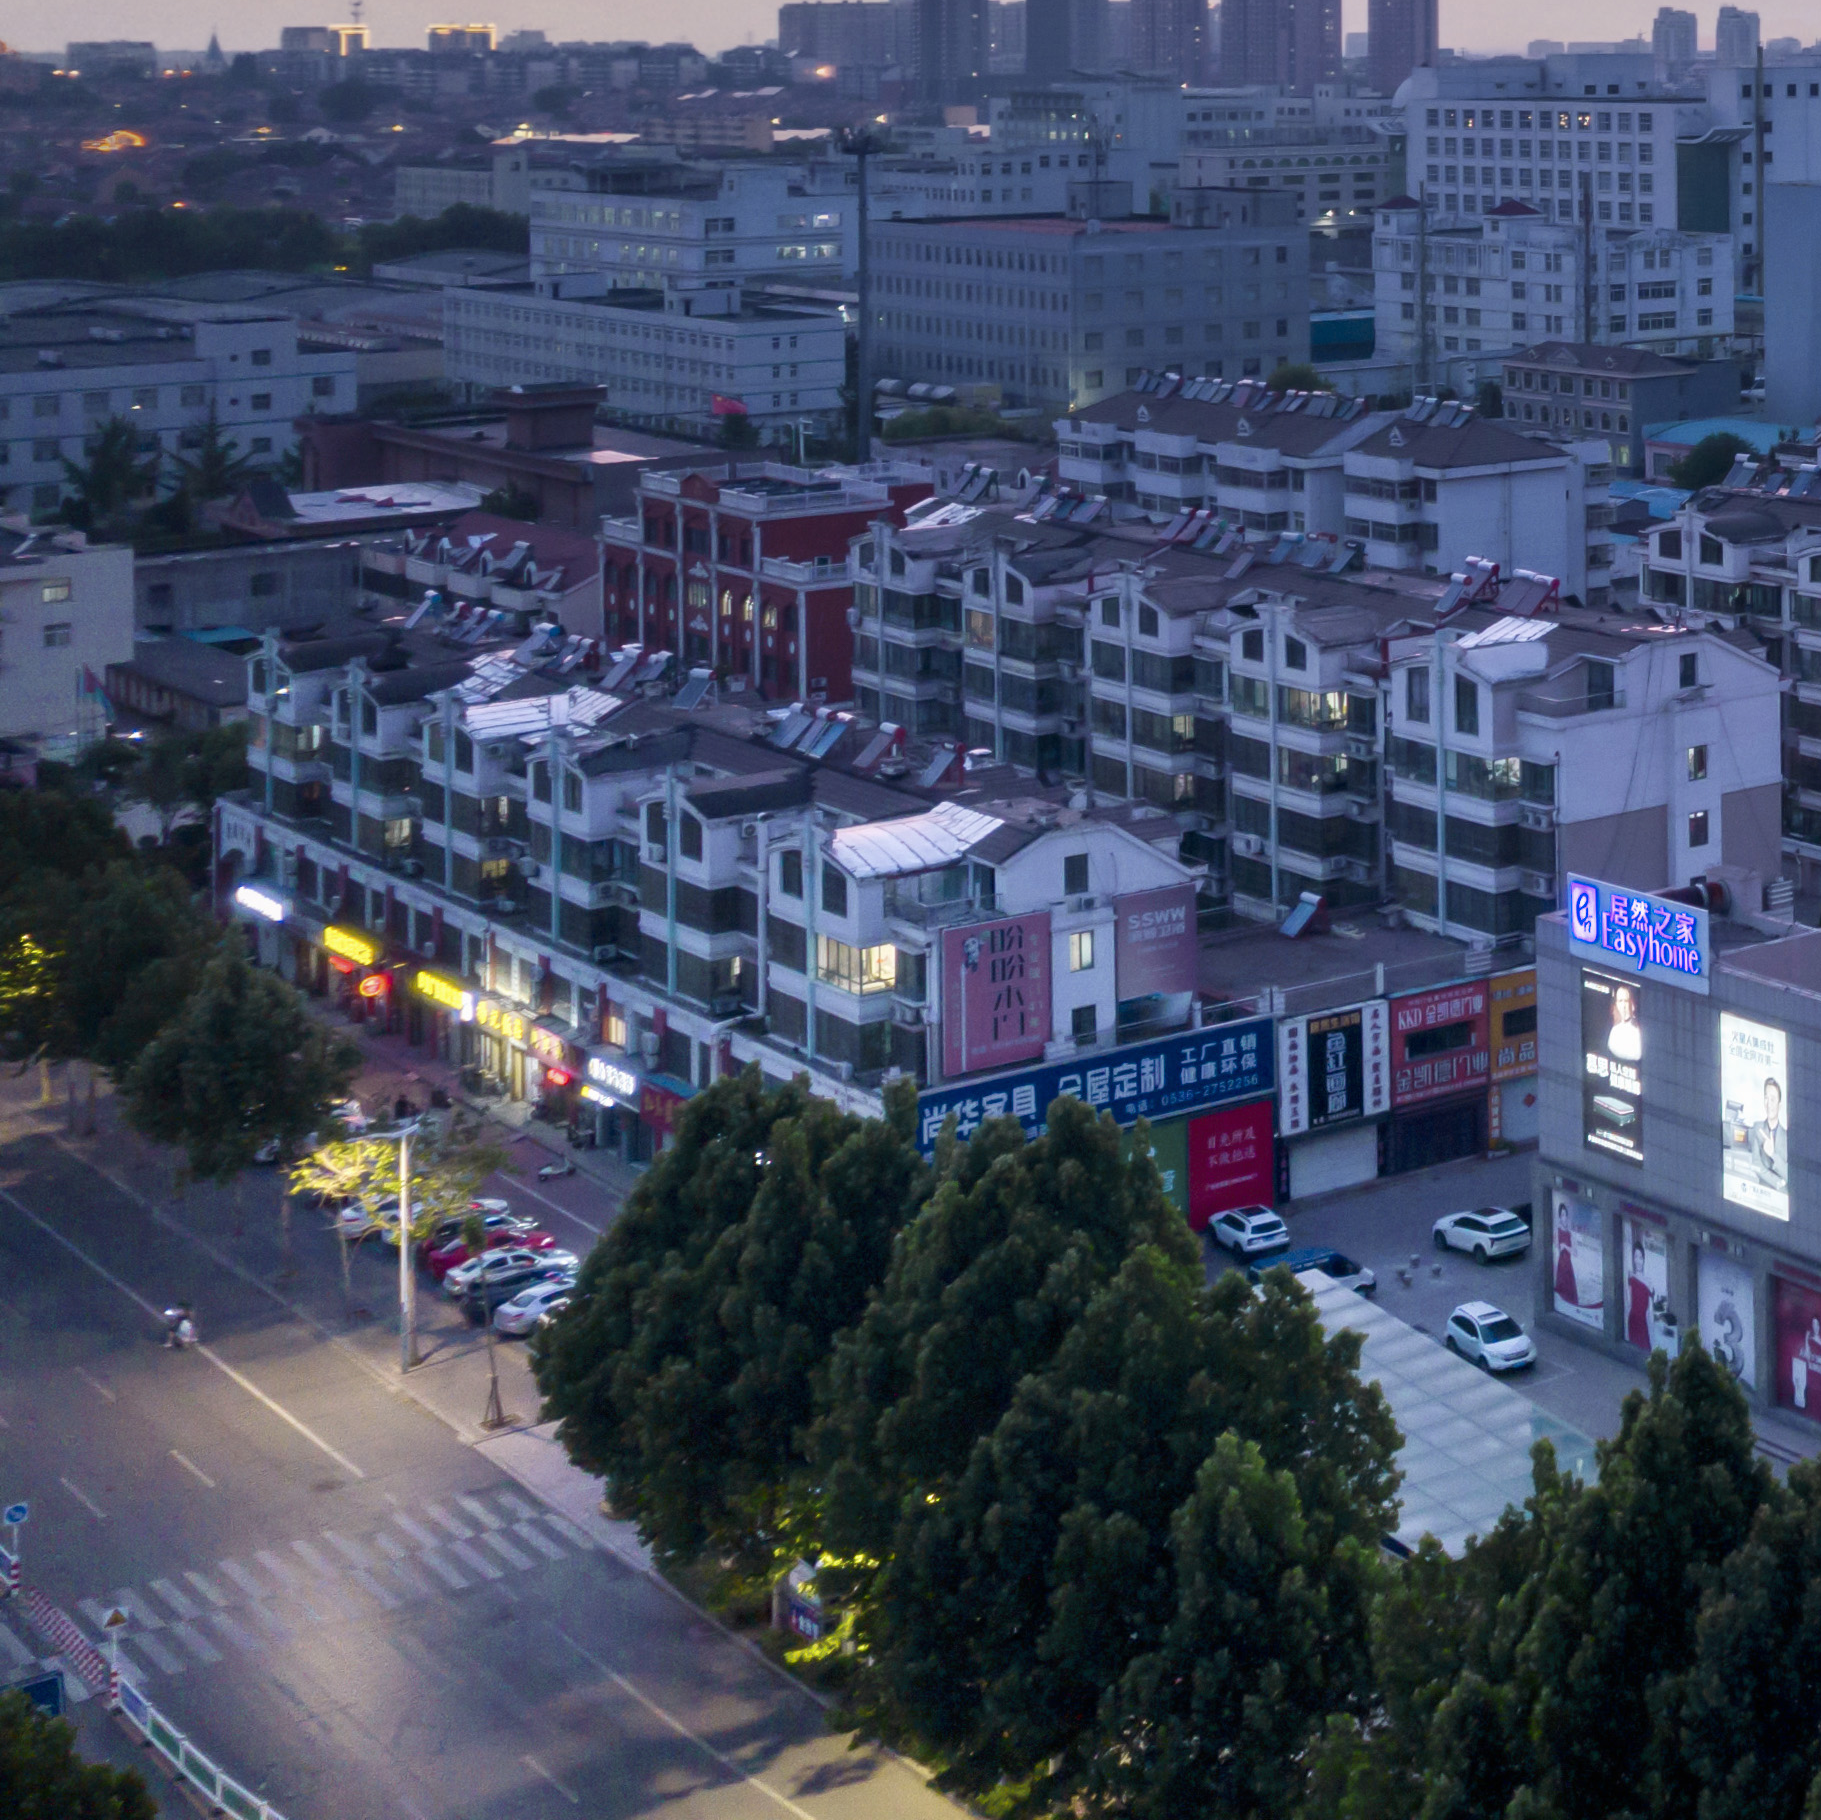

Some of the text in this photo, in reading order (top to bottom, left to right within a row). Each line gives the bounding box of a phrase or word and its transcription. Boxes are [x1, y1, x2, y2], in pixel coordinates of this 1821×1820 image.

[1127, 905, 1186, 930] SSWW
[1609, 894, 1696, 945] 居然之家
[1602, 911, 1700, 974] Easyhome
[1398, 1008, 1423, 1031] KKD
[1180, 1032, 1258, 1065] 工厂直销
[1179, 1052, 1258, 1086] 健康环保
[1394, 1050, 1489, 1094] 金凯德门业
